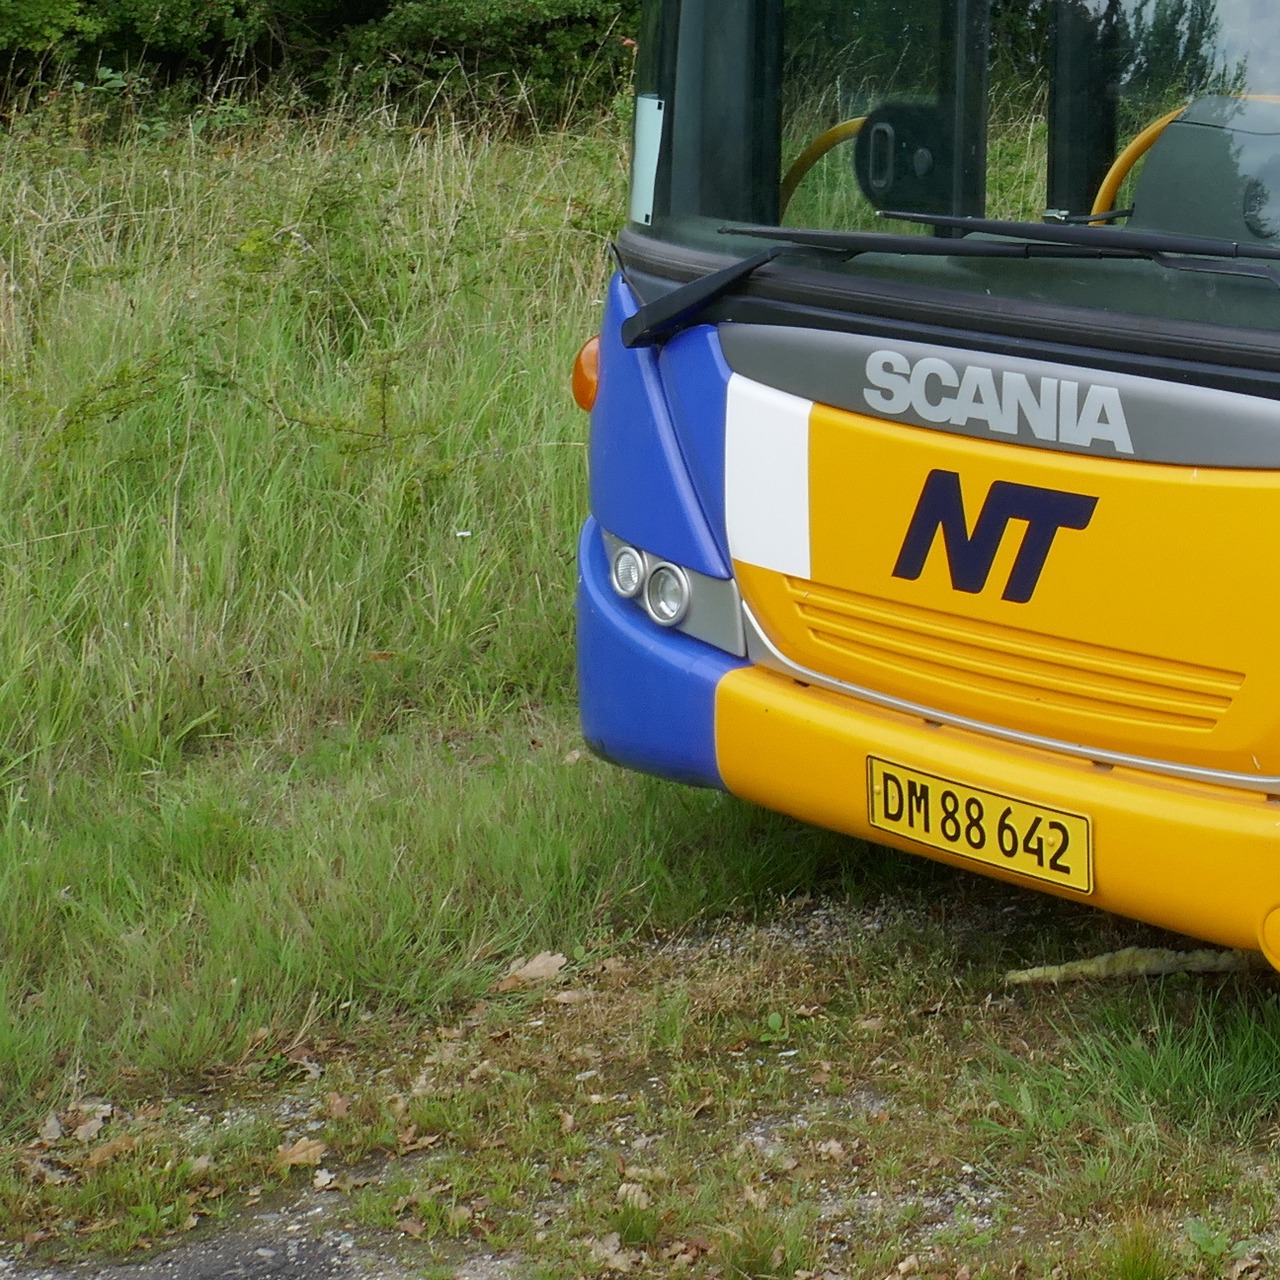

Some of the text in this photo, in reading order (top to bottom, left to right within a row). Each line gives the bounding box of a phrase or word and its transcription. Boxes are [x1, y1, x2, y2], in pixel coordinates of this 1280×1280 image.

[863, 350, 1134, 454] SCANIA
[891, 469, 1099, 604] NT
[881, 772, 1071, 875] DM 88 642
